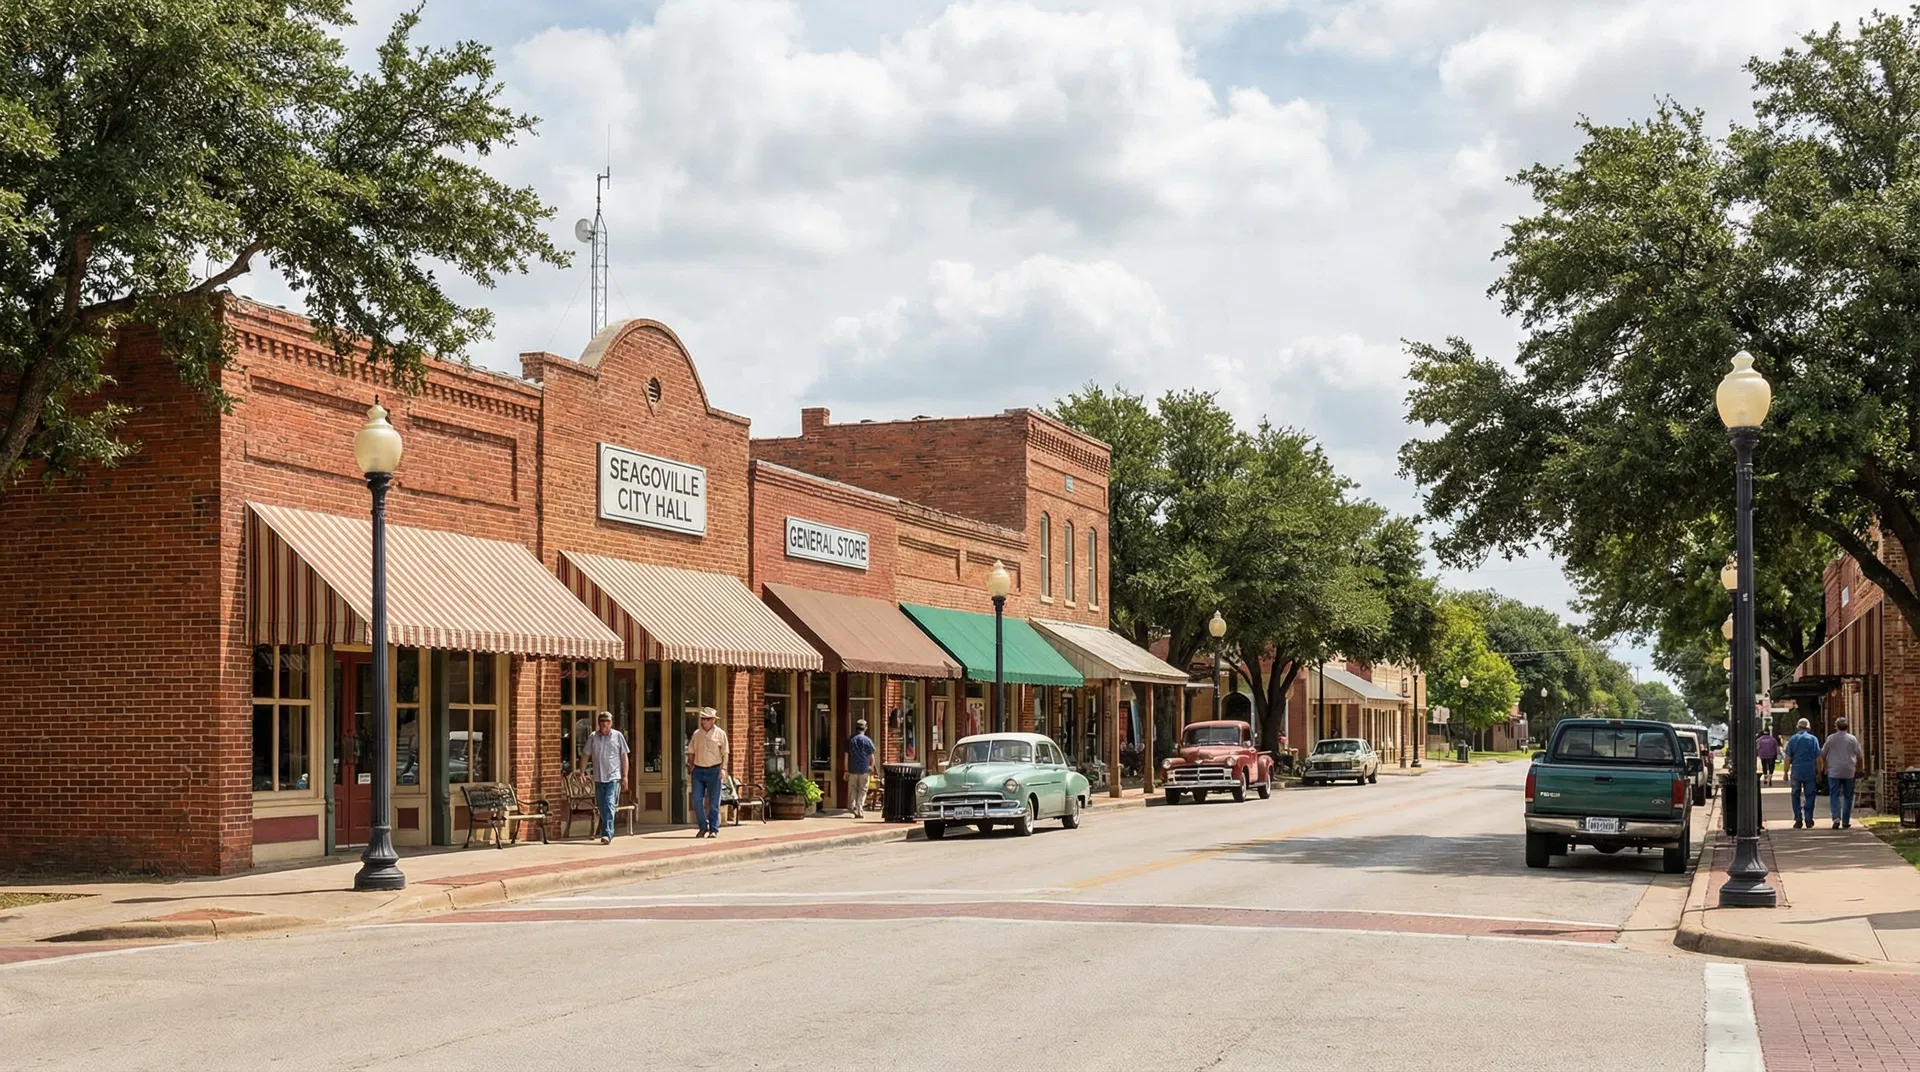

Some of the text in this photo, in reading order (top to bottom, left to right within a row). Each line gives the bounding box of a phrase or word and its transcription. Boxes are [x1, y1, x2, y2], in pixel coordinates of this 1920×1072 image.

[610, 457, 699, 497] SEAGOVILLE
[618, 487, 692, 522] CITY HALL
[790, 526, 867, 560] GENERAL STORE
